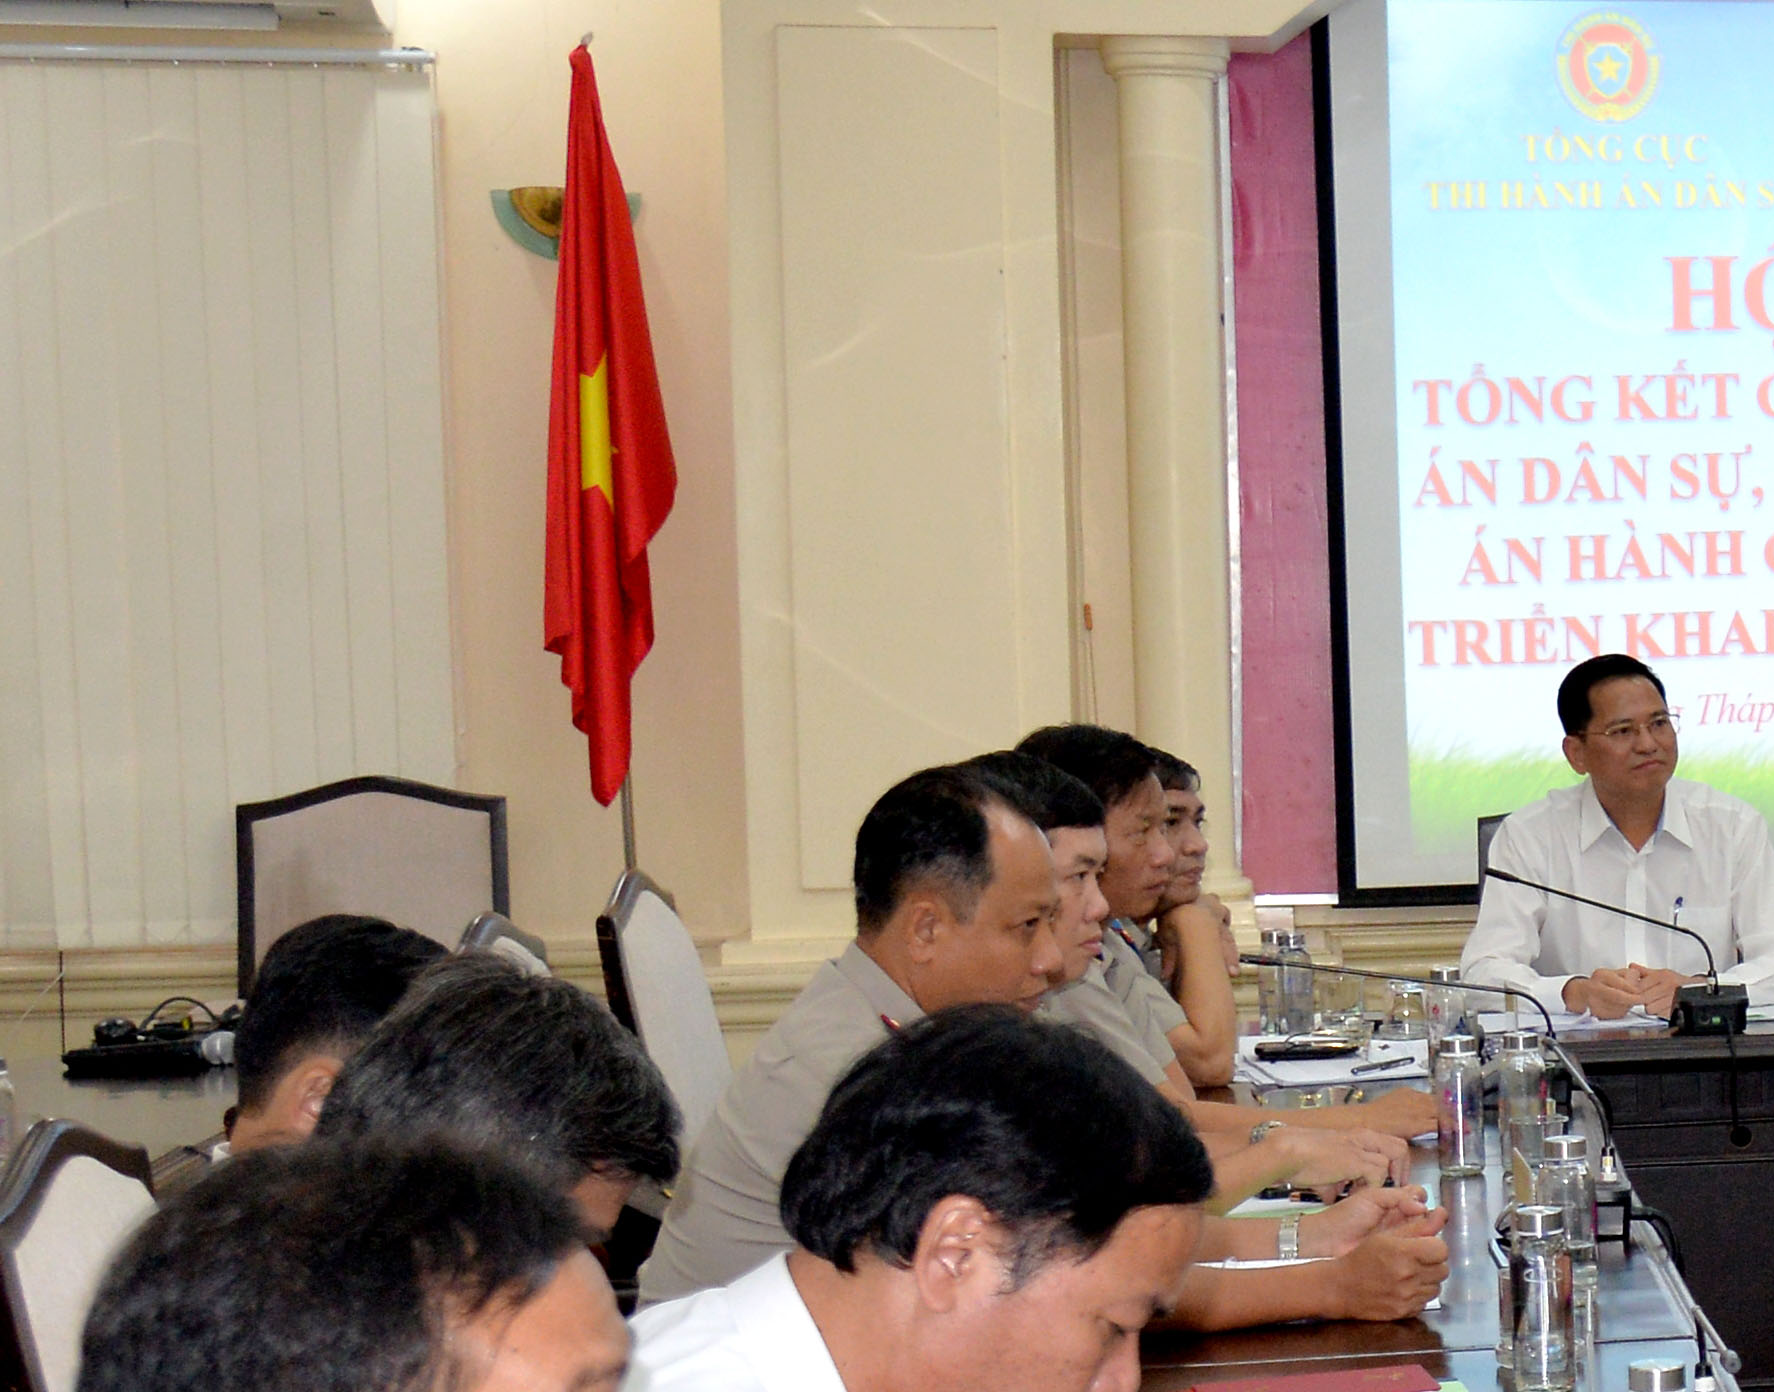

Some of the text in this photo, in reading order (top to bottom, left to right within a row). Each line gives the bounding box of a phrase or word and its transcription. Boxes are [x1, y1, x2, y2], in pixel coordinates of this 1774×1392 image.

[1520, 126, 1708, 170] TỔNG CỤC
[1424, 179, 1488, 210] THI
[1499, 173, 1603, 210] HÀNH
[1616, 172, 1663, 210] ÁN
[1674, 172, 1747, 210] DÂN
[1412, 362, 1597, 427] TỔNG
[1612, 358, 1741, 422] KẾT
[1413, 446, 1500, 508] ÁN
[1518, 440, 1651, 505] DÂN
[1669, 442, 1765, 513] SỰ,
[1458, 524, 1544, 586] ÁN
[1565, 519, 1746, 582] HÀNH
[1408, 602, 1602, 667] TRIỂN
